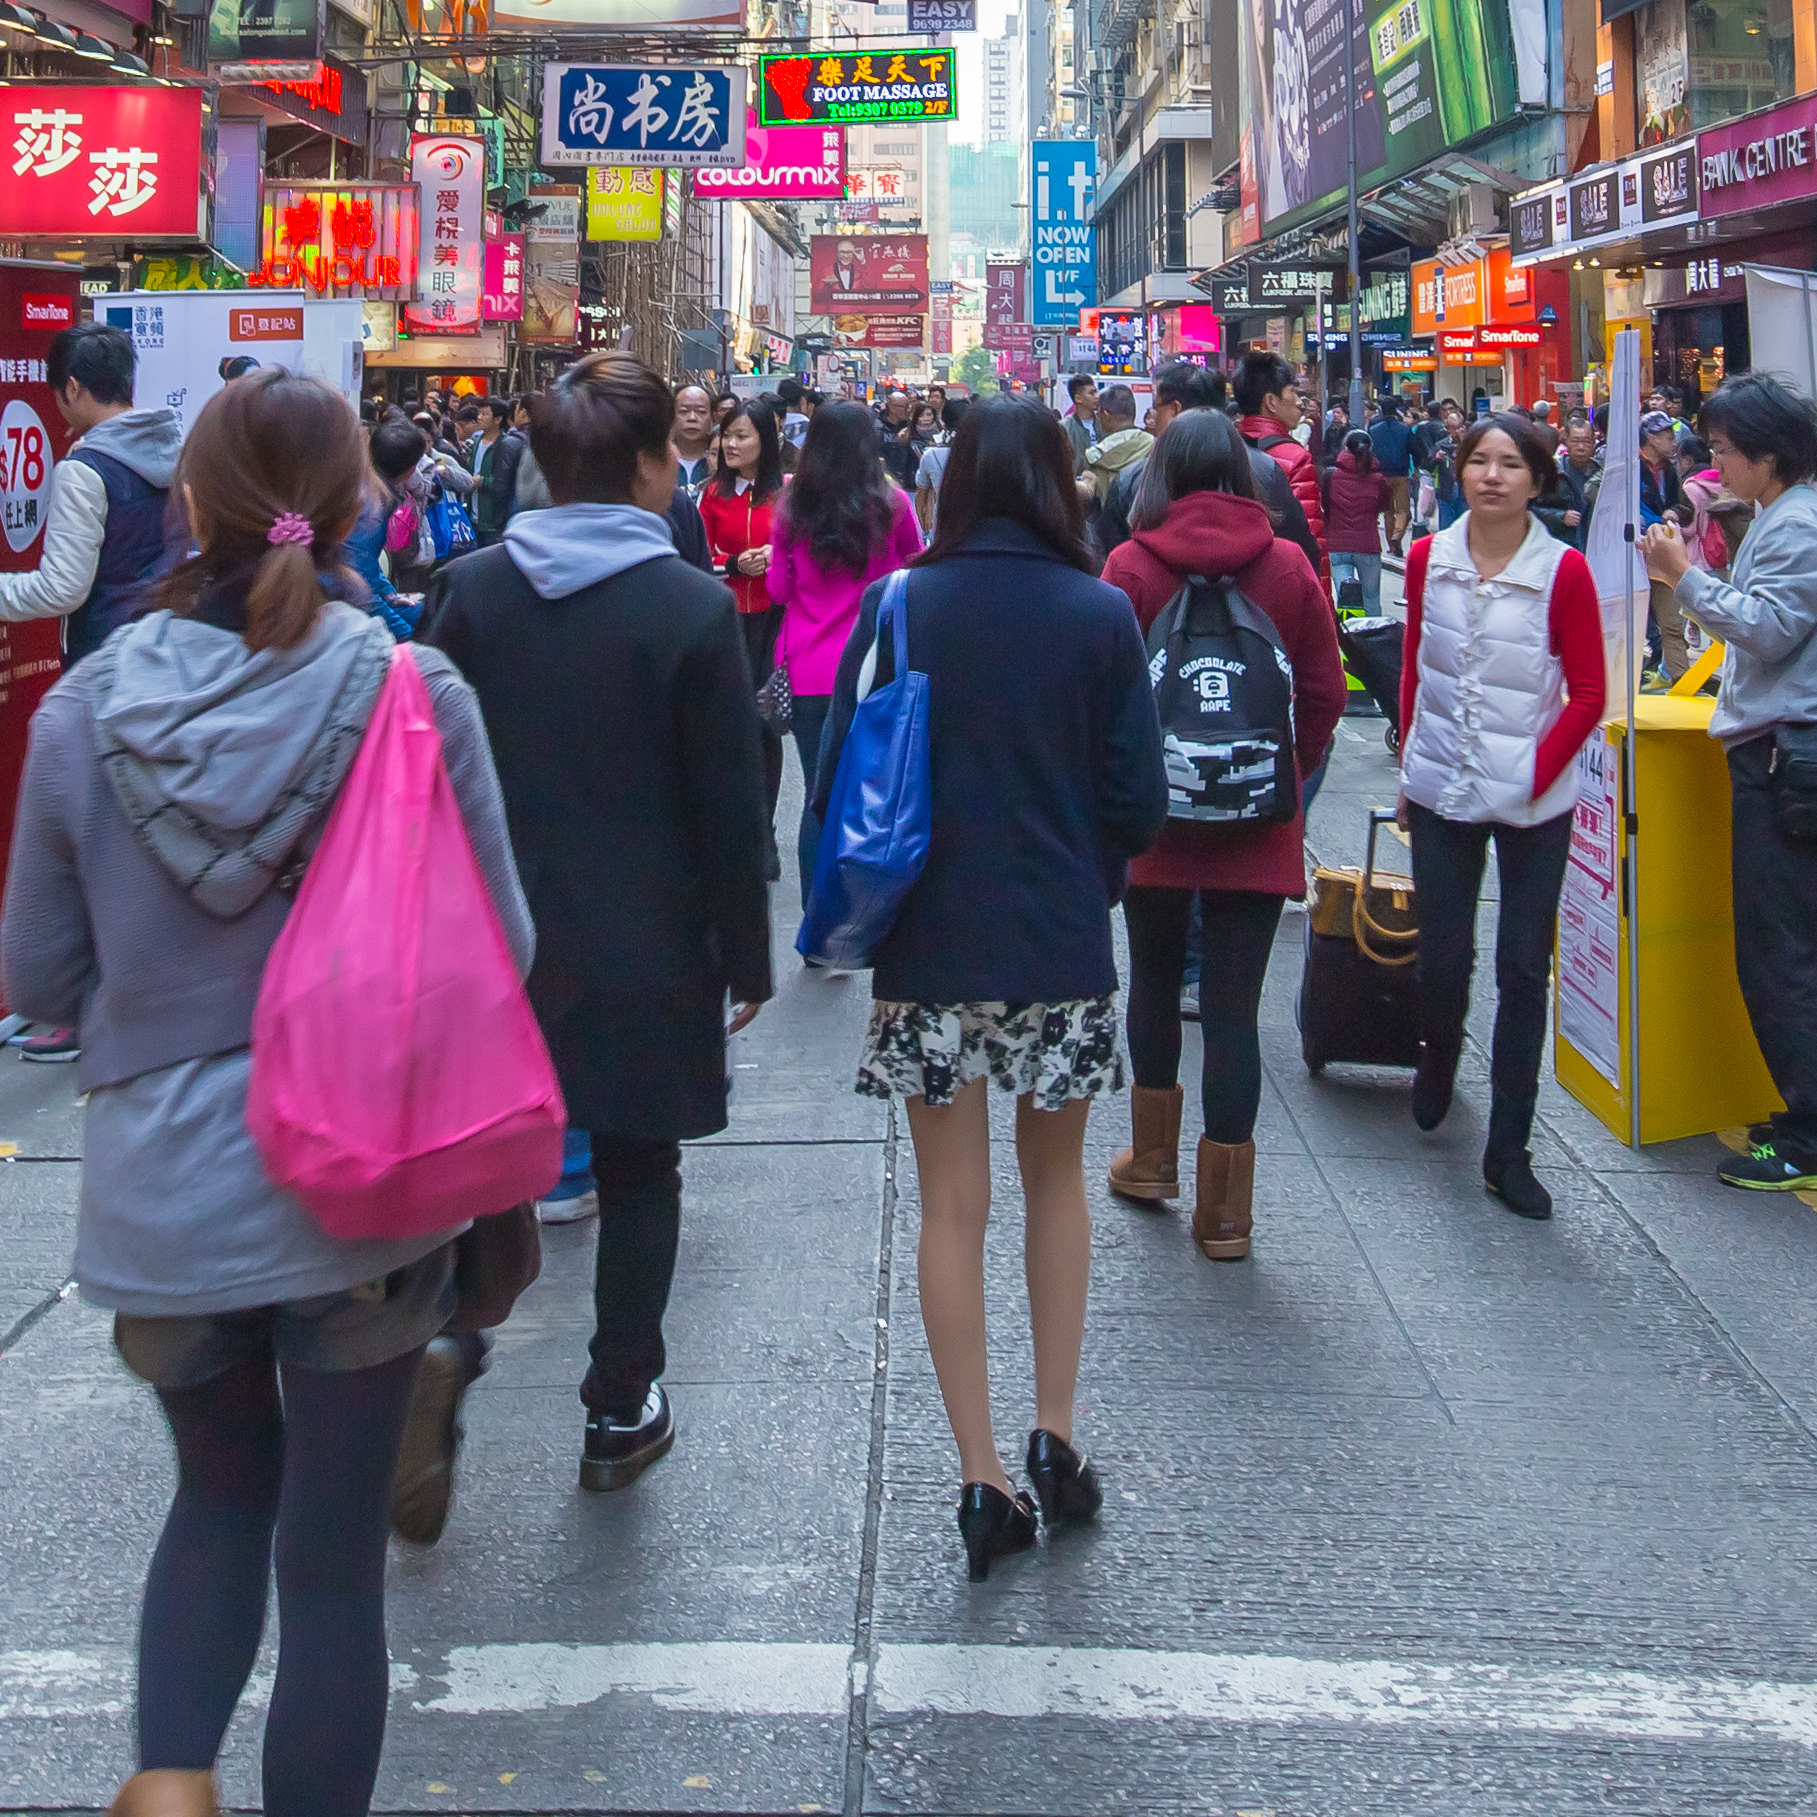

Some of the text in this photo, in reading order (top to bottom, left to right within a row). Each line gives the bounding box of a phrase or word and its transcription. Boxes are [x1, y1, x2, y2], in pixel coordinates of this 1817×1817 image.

[912, 0, 972, 18] EASY
[944, 19, 974, 30] 2348
[812, 82, 949, 102] FOOT MASSAGE
[569, 70, 721, 149] 尚书房
[11, 108, 159, 218] 莎莎
[1702, 148, 1744, 192] BANK
[1745, 126, 1808, 179] CENTRE
[594, 166, 656, 196] 動感
[1037, 226, 1090, 244] NOW
[1036, 246, 1090, 264] OPEN
[1057, 269, 1080, 284] 1/F
[25, 302, 70, 322] SmarTone
[896, 316, 919, 325] KFC
[1480, 329, 1541, 344] SmarTone
[1199, 698, 1232, 714] AAPE
